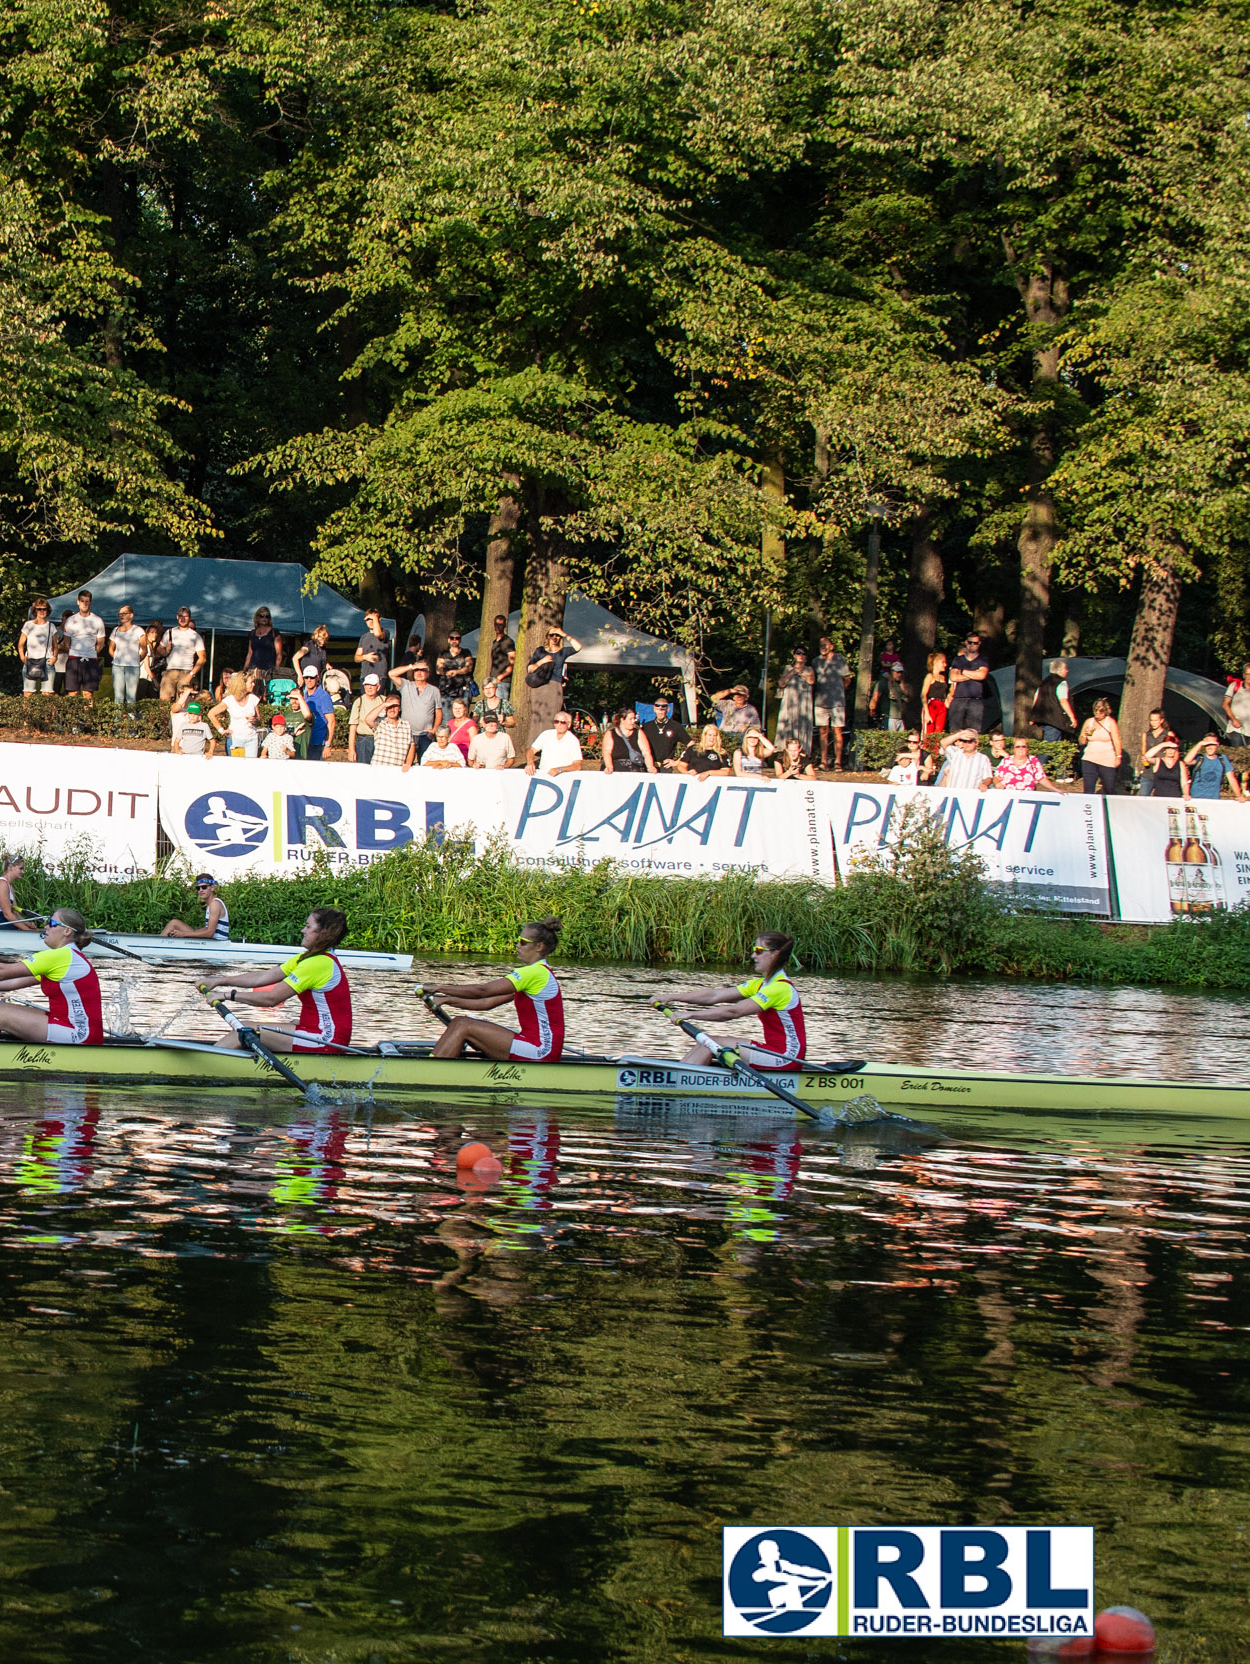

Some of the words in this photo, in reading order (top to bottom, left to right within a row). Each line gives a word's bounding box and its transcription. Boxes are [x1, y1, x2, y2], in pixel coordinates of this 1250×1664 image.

[514, 777, 777, 850] PLANAT
[805, 789, 820, 877] www.planat.de
[1083, 803, 1097, 879] www.planat.de
[620, 857, 692, 871] software
[712, 860, 769, 874] service
[1005, 864, 1055, 876] service
[11, 1045, 52, 1064] Melitta
[482, 1062, 522, 1082] Melitta
[639, 1070, 676, 1084] RBL
[805, 1077, 816, 1089] Z
[818, 1077, 838, 1089] BS
[840, 1077, 865, 1089] 001
[900, 1079, 929, 1092] Erich
[931, 1081, 972, 1094] Domeier
